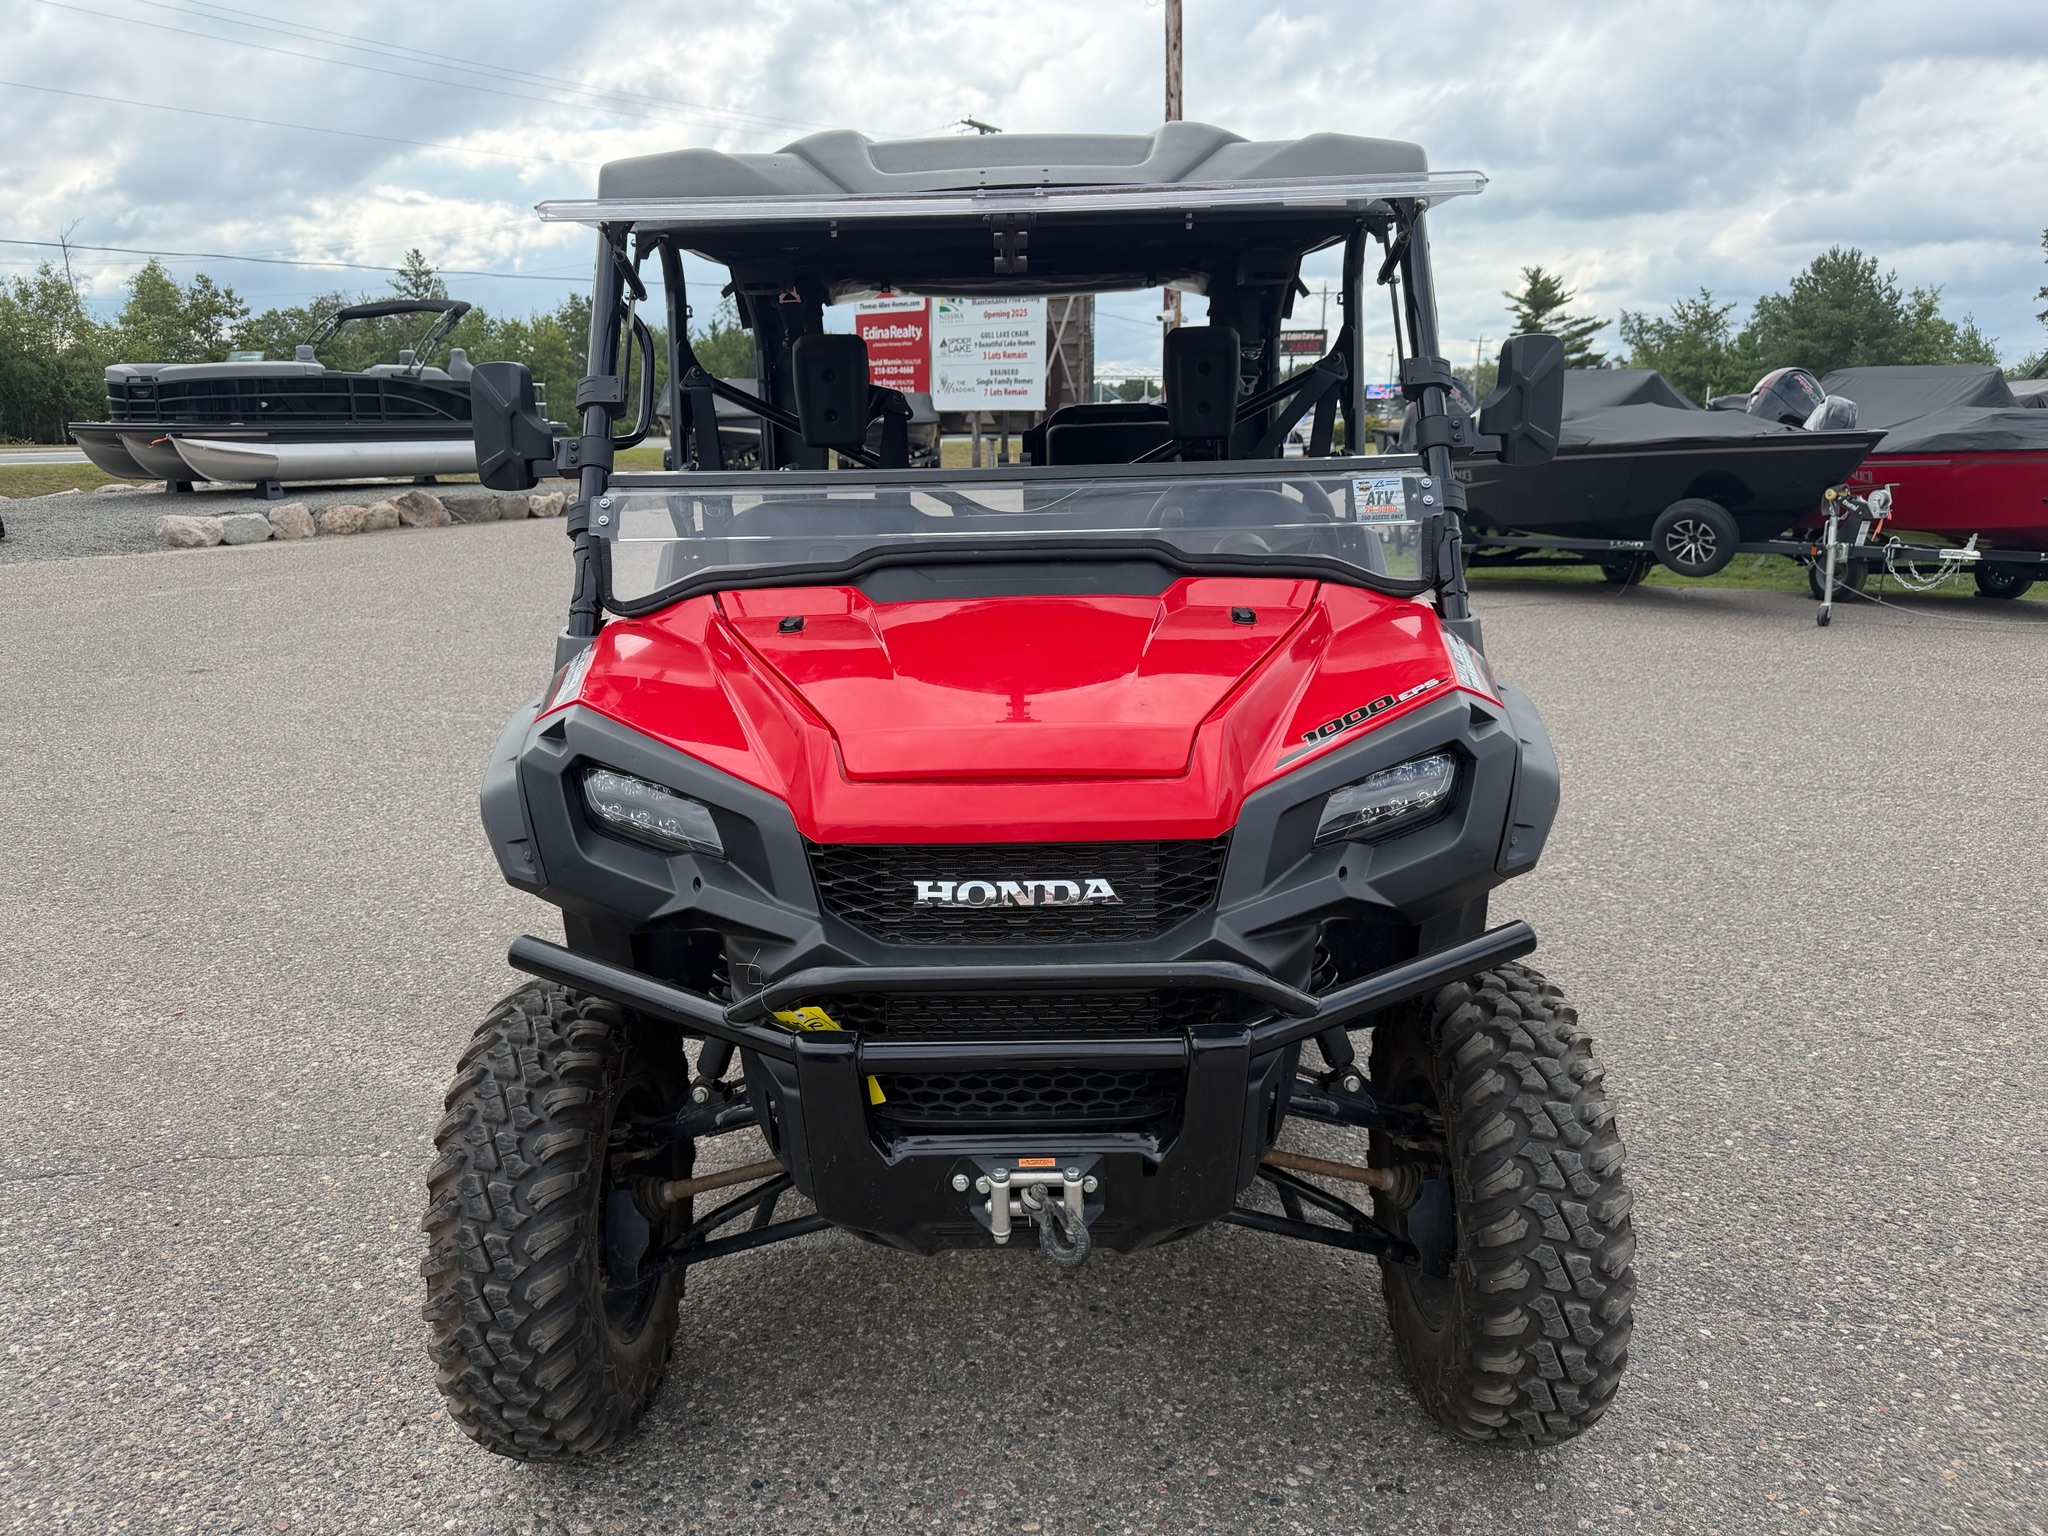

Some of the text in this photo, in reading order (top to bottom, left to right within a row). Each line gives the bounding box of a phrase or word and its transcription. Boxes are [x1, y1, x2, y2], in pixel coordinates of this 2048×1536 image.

[983, 310, 1010, 320] Opening
[980, 330, 1029, 339] GULL LAKE CHAIN
[948, 344, 972, 353] LAKE
[979, 340, 1003, 348] Beautiful
[1017, 339, 1036, 347] Homes
[983, 351, 987, 360] 3
[988, 351, 1001, 360] Lots
[1002, 350, 1028, 360] Remain
[976, 377, 1033, 387] Single Family Homes
[984, 387, 1028, 396] 7 Lots Remain
[1366, 490, 1395, 505] ATV
[1610, 540, 1644, 549] LUND
[1301, 678, 1440, 747] 1000 EPS
[913, 878, 1124, 909] HONDA
